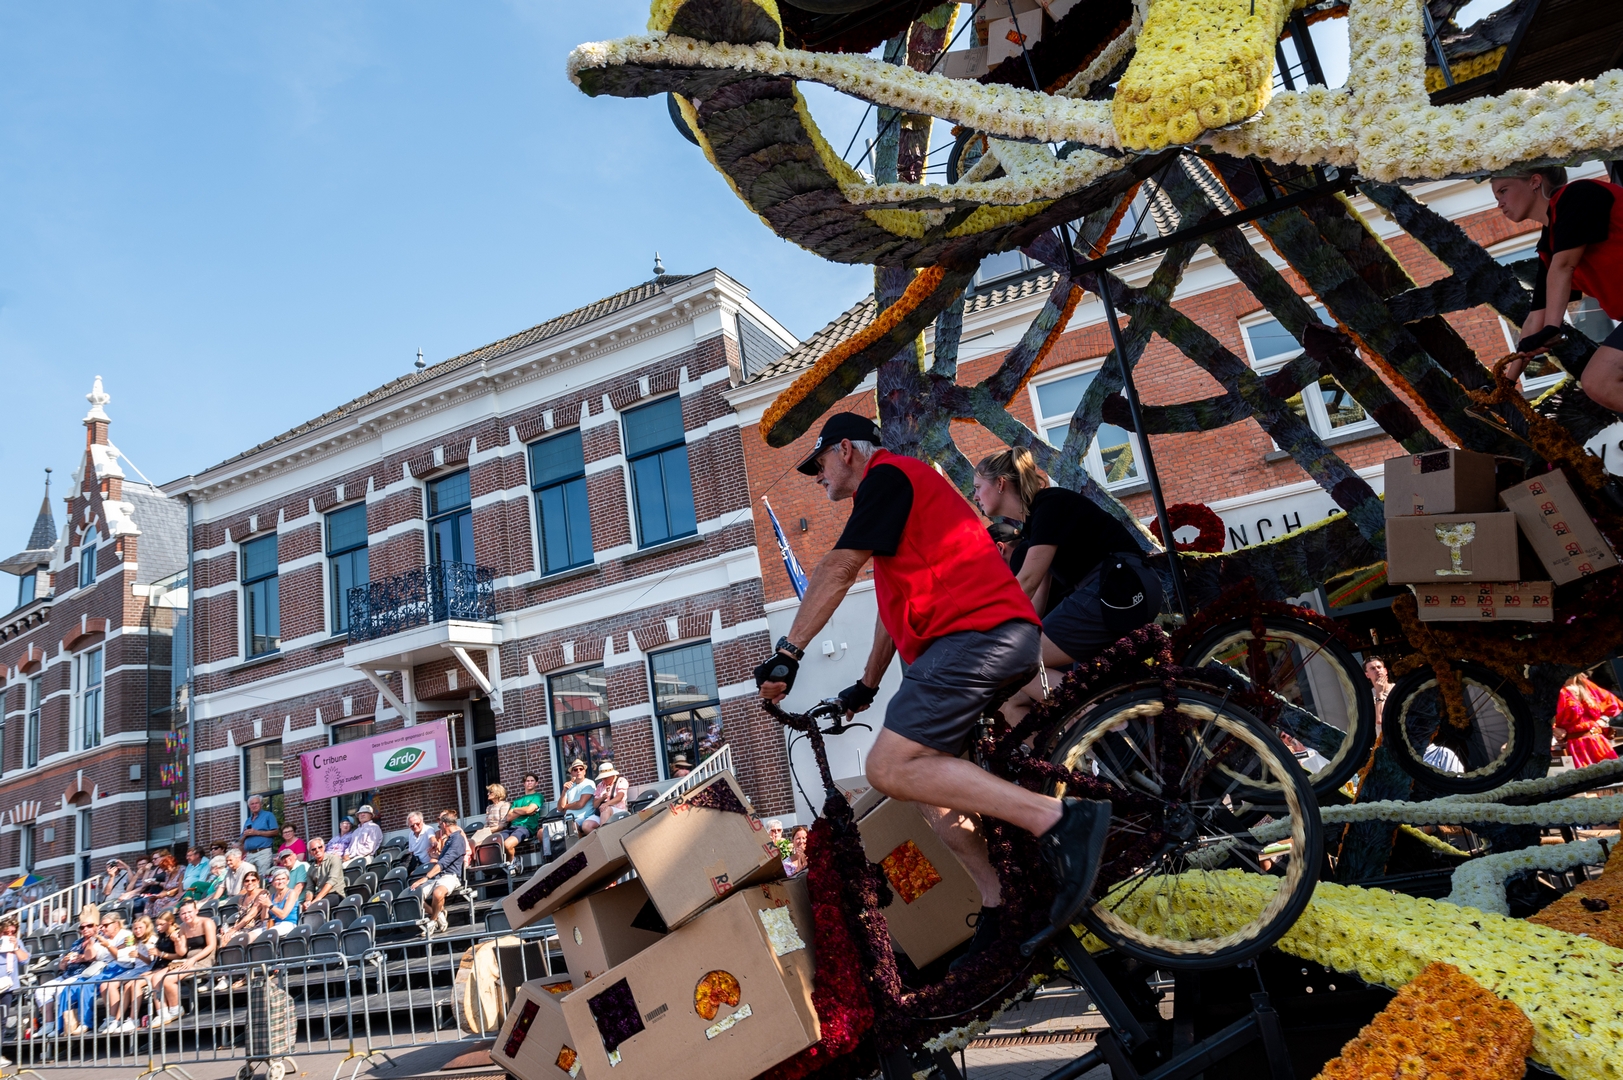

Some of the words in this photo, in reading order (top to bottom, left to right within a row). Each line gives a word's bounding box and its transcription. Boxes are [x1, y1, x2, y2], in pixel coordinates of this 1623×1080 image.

[1529, 481, 1546, 496] RB
[1541, 501, 1558, 516] RB
[1228, 511, 1302, 551] NCH
[1553, 521, 1571, 537] RB
[1565, 541, 1584, 557] RB
[1424, 595, 1440, 606] RB
[1450, 595, 1466, 606] RB
[1477, 595, 1493, 606] RB
[1504, 595, 1521, 606] RB
[1532, 595, 1550, 606] RB
[313, 754, 321, 769] C
[323, 754, 347, 766] tribune
[389, 752, 416, 767] ardo
[710, 872, 733, 896] RB
